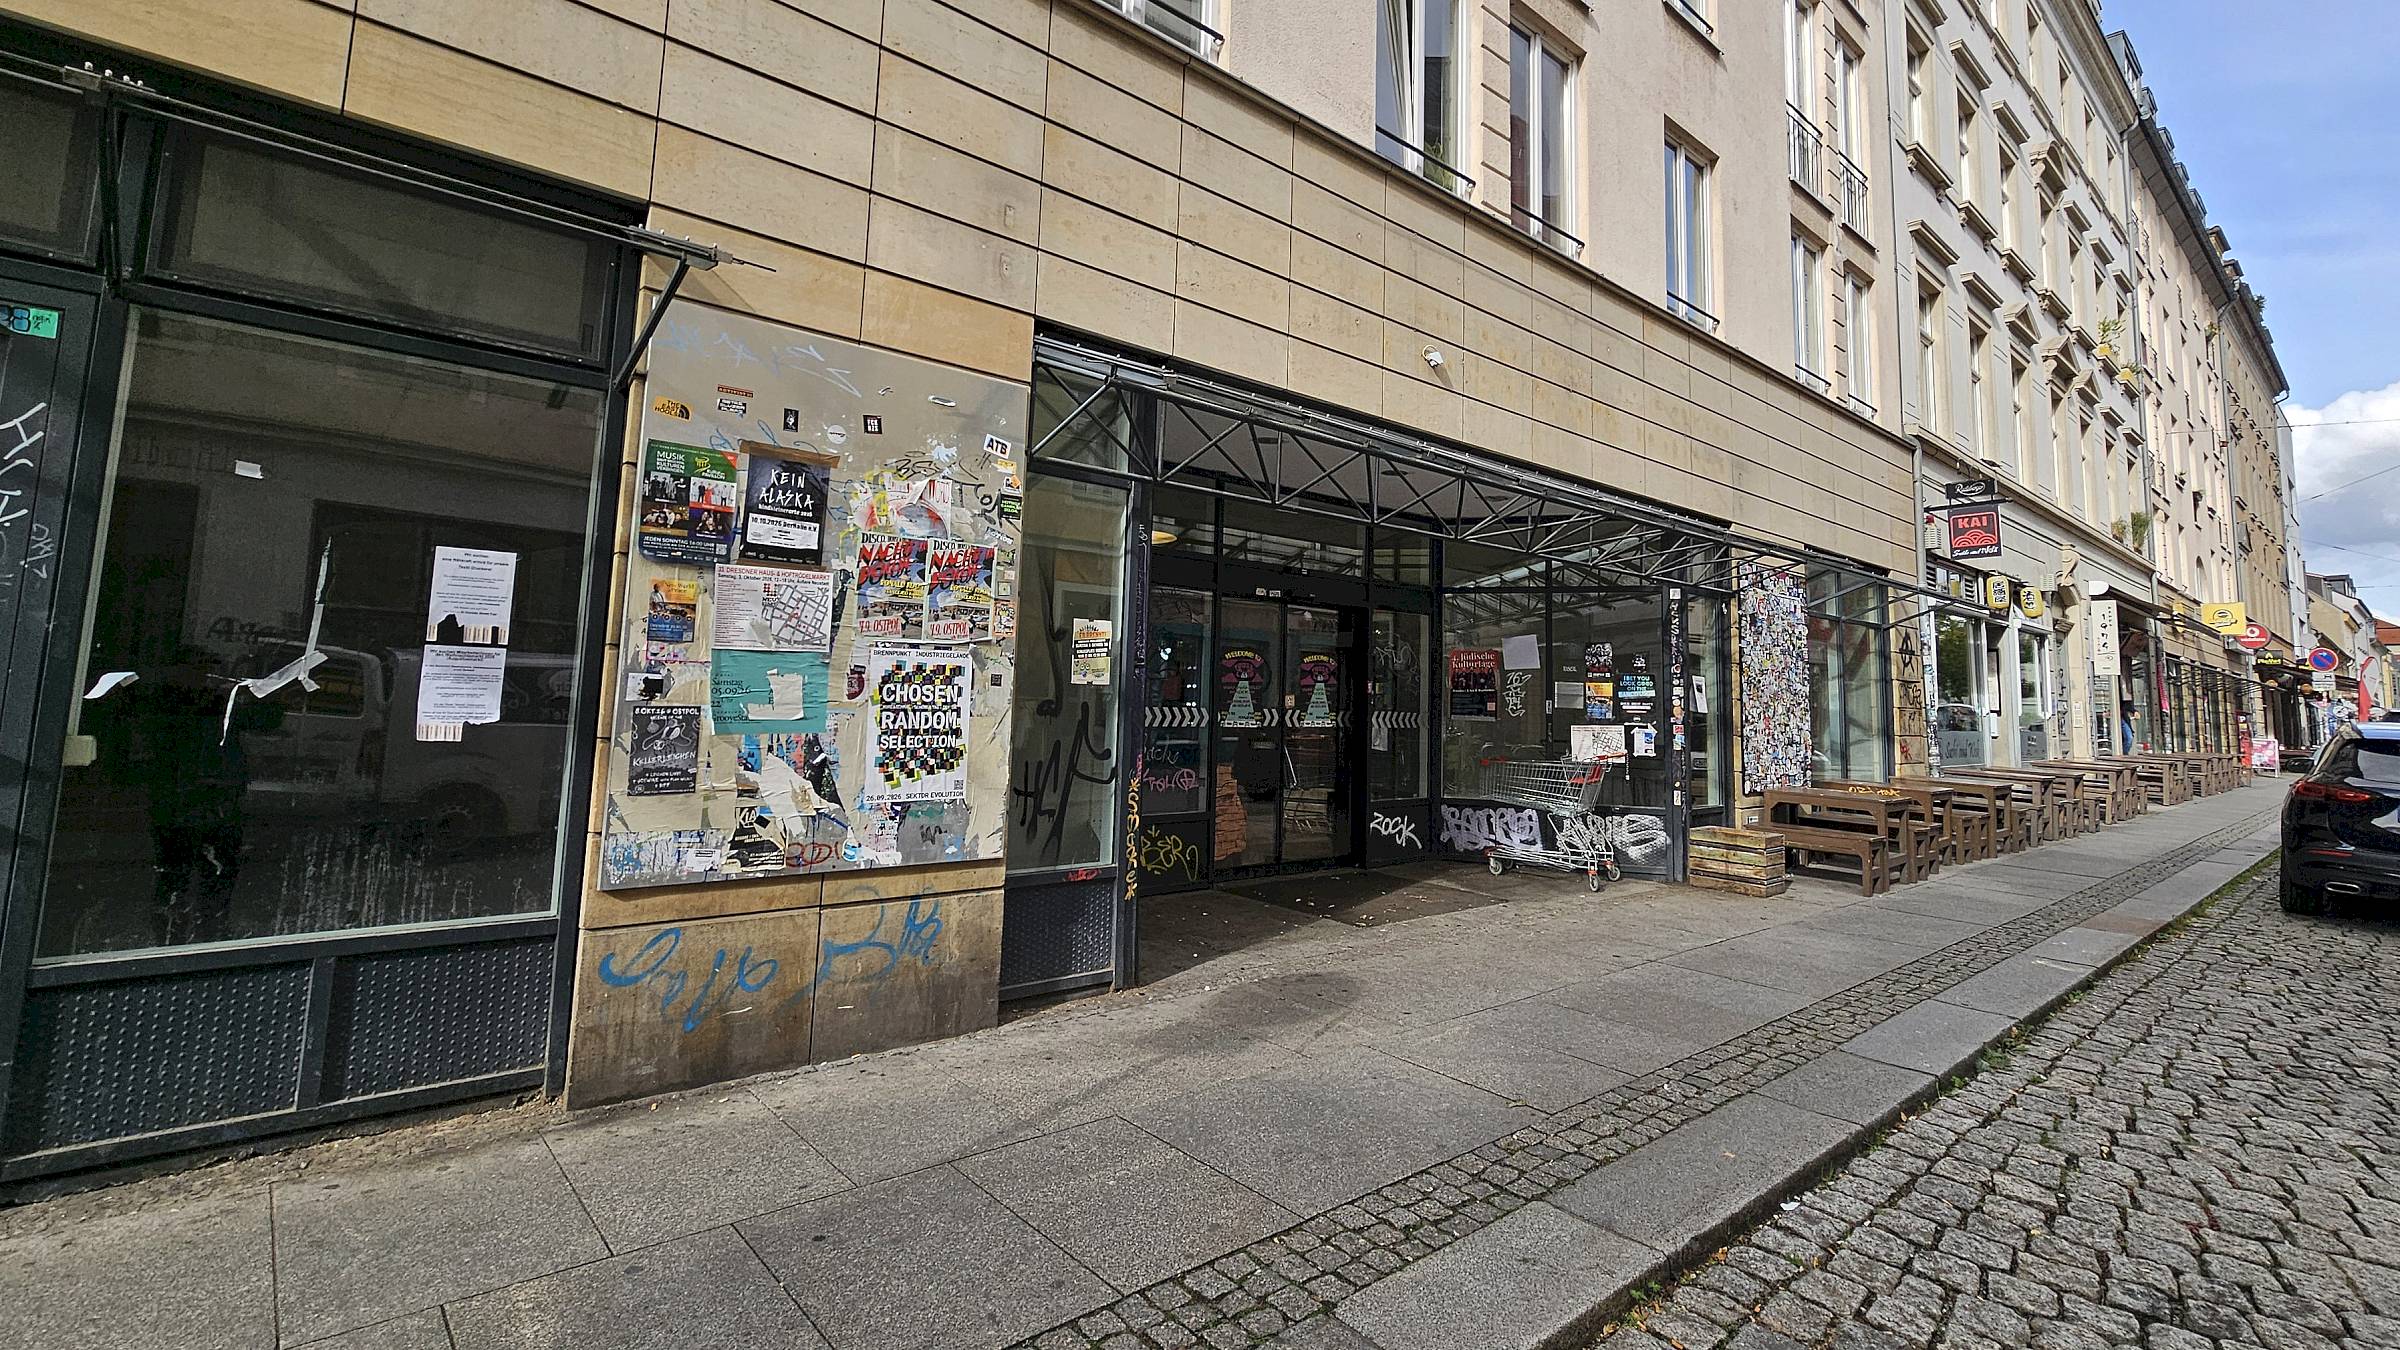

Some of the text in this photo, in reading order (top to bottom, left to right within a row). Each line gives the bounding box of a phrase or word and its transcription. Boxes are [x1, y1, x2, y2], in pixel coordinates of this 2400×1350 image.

[987, 438, 1008, 454] ATB
[656, 451, 685, 461] MUSIK
[770, 469, 806, 488] KEIN
[758, 487, 815, 510] ALASKA
[1957, 516, 1988, 528] KAI
[662, 537, 688, 545] SONNTAG
[726, 567, 759, 575] DRESDNER
[873, 649, 911, 657] BRENNPUNKT
[1225, 650, 1255, 660] WELCOME
[1460, 652, 1496, 661] Jüdische
[1303, 654, 1330, 663] WELCOME
[1452, 660, 1496, 669] Kulturtage
[882, 683, 959, 703] CHOSEN
[880, 711, 958, 730] RANDOM
[879, 735, 957, 749] SELECTION
[633, 751, 696, 766] KELLERLEICHEN
[930, 790, 964, 798] EVOLUTION
